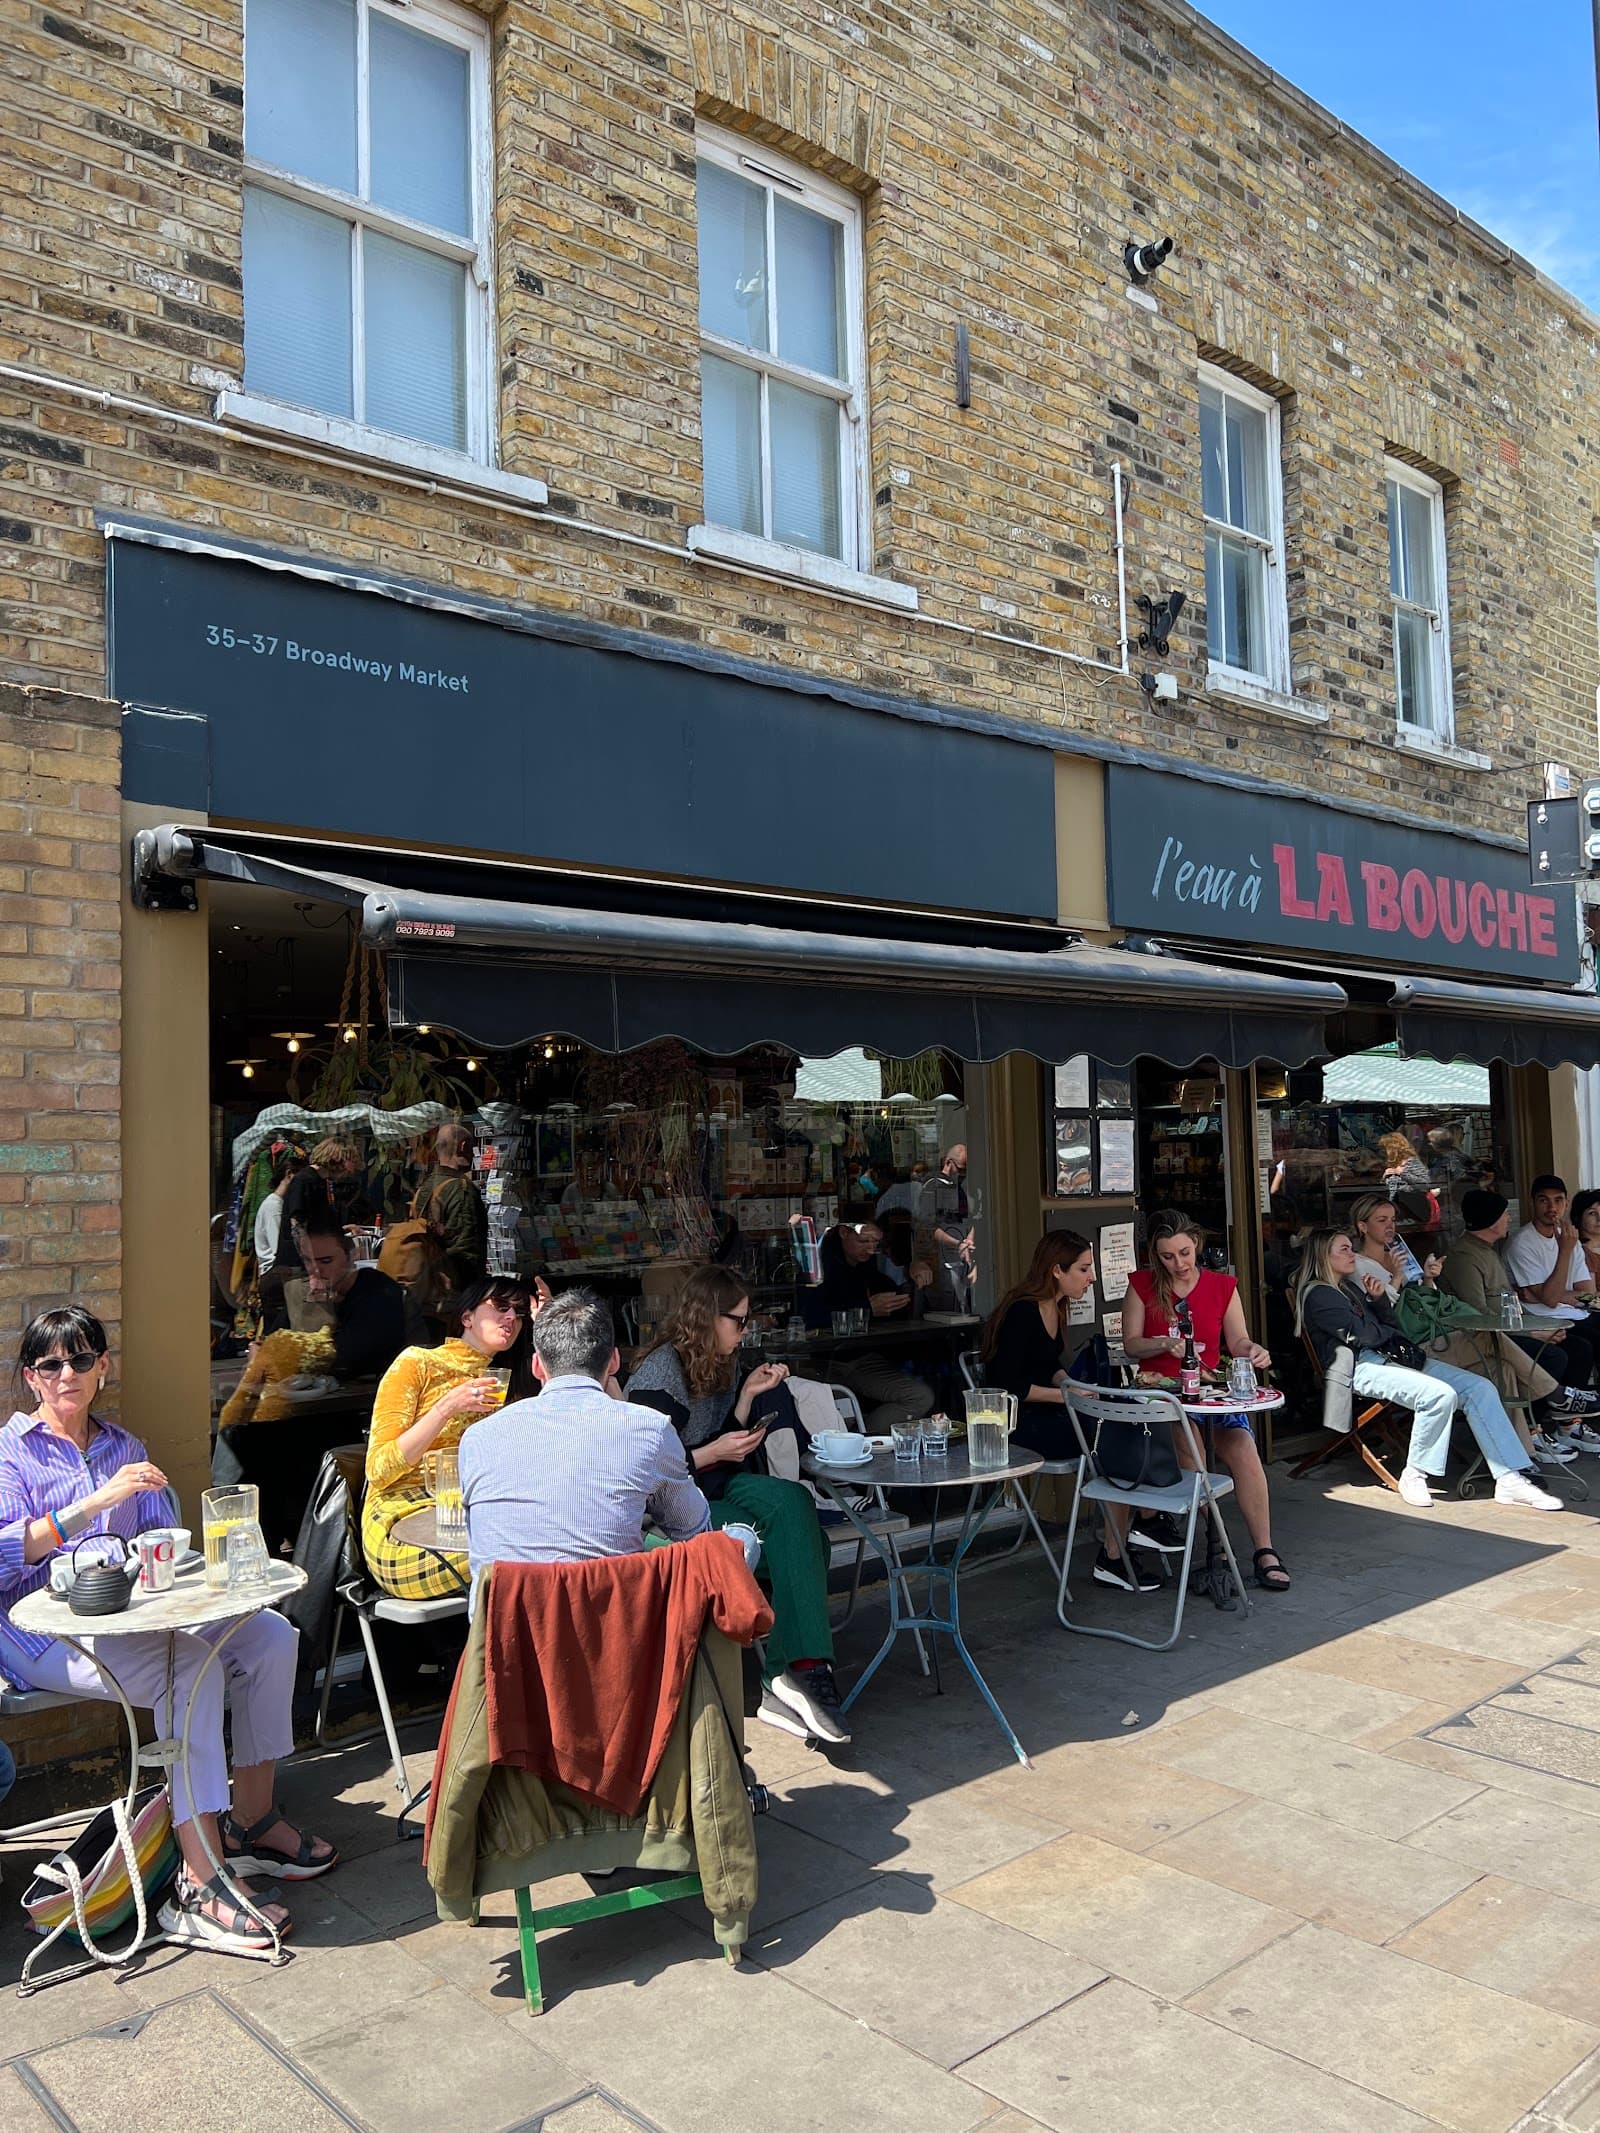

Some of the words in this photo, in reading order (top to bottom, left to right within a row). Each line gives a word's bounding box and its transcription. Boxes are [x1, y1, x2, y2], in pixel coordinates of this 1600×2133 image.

[286, 640, 393, 682] Broadway
[399, 662, 470, 693] Market
[1151, 836, 1237, 912] l'eau
[1239, 853, 1262, 914] à
[1272, 843, 1355, 926] LA
[1360, 860, 1559, 958] BOUCHE
